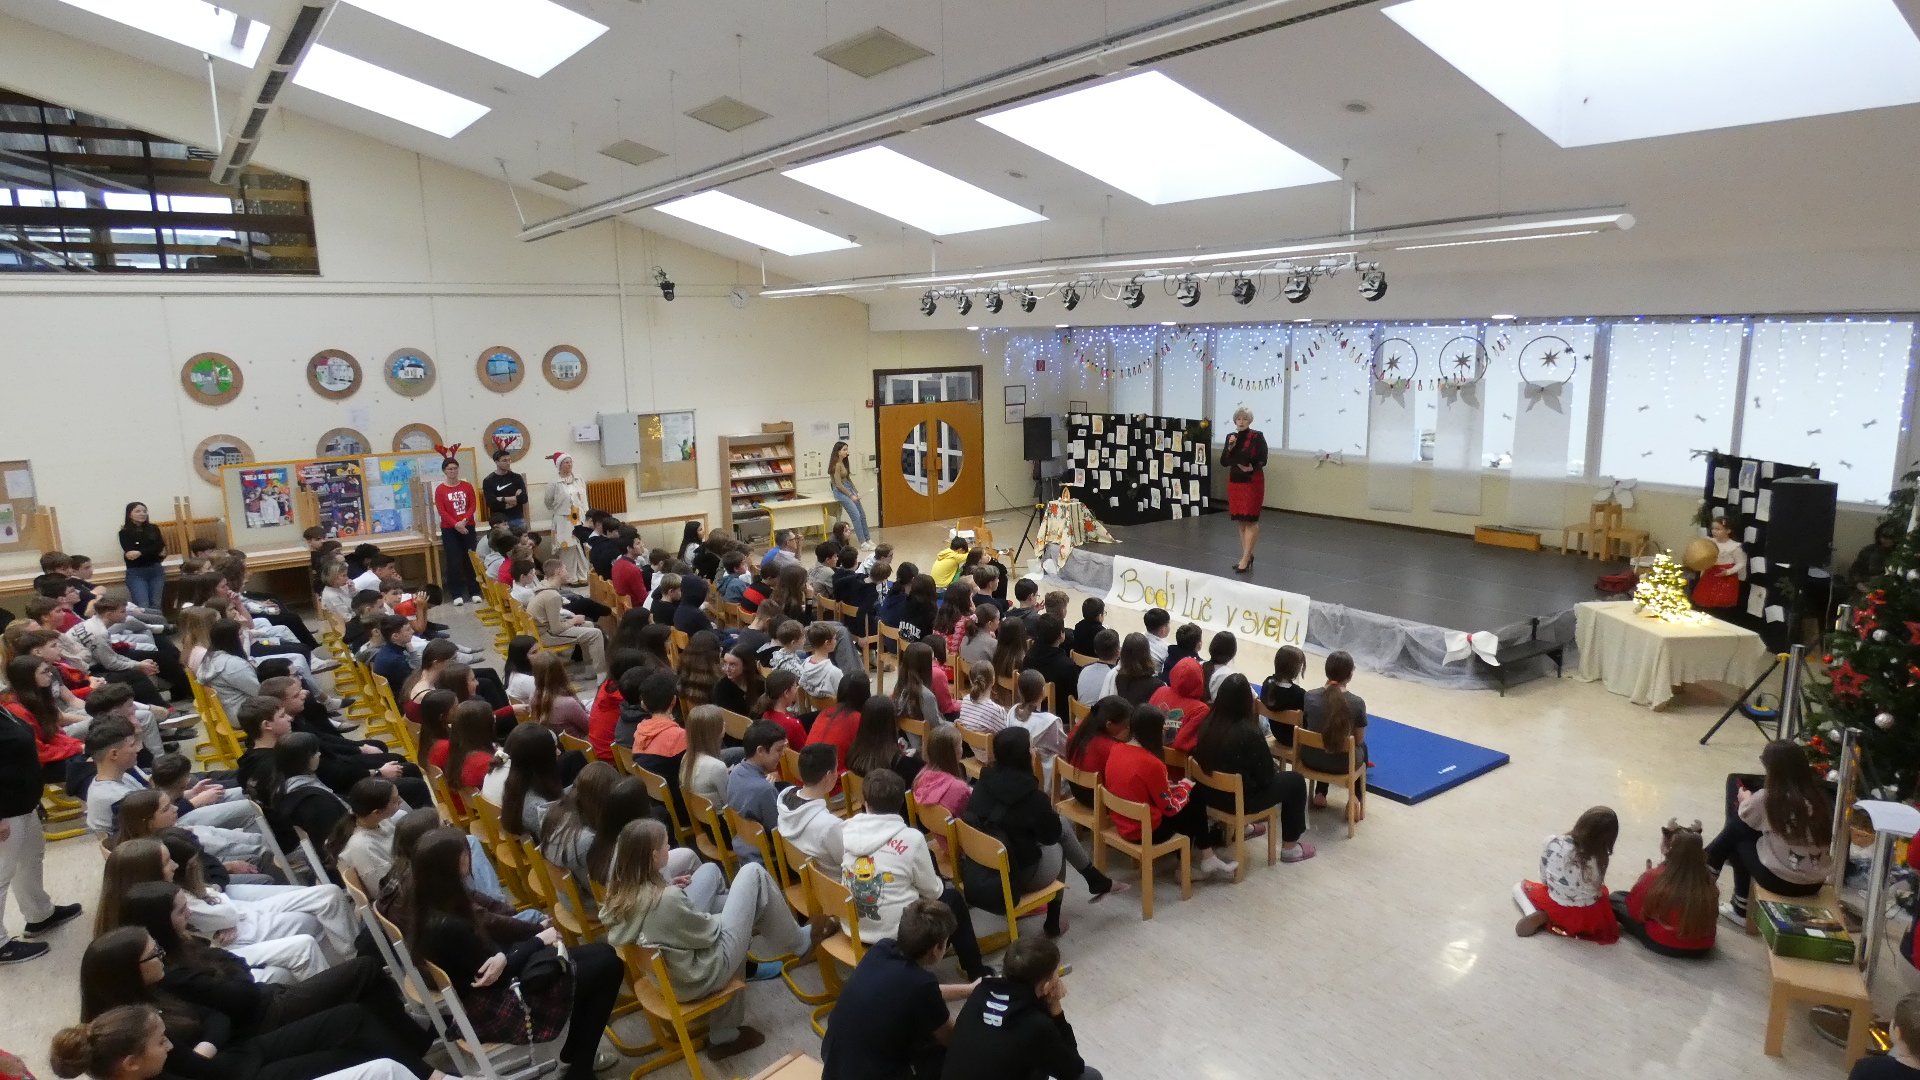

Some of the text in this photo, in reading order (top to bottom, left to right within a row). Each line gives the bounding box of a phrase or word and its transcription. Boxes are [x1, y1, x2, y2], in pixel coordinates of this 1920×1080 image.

[1117, 568, 1175, 612] Bodi
[1226, 605, 1238, 628] v
[1241, 598, 1299, 645] svetu
